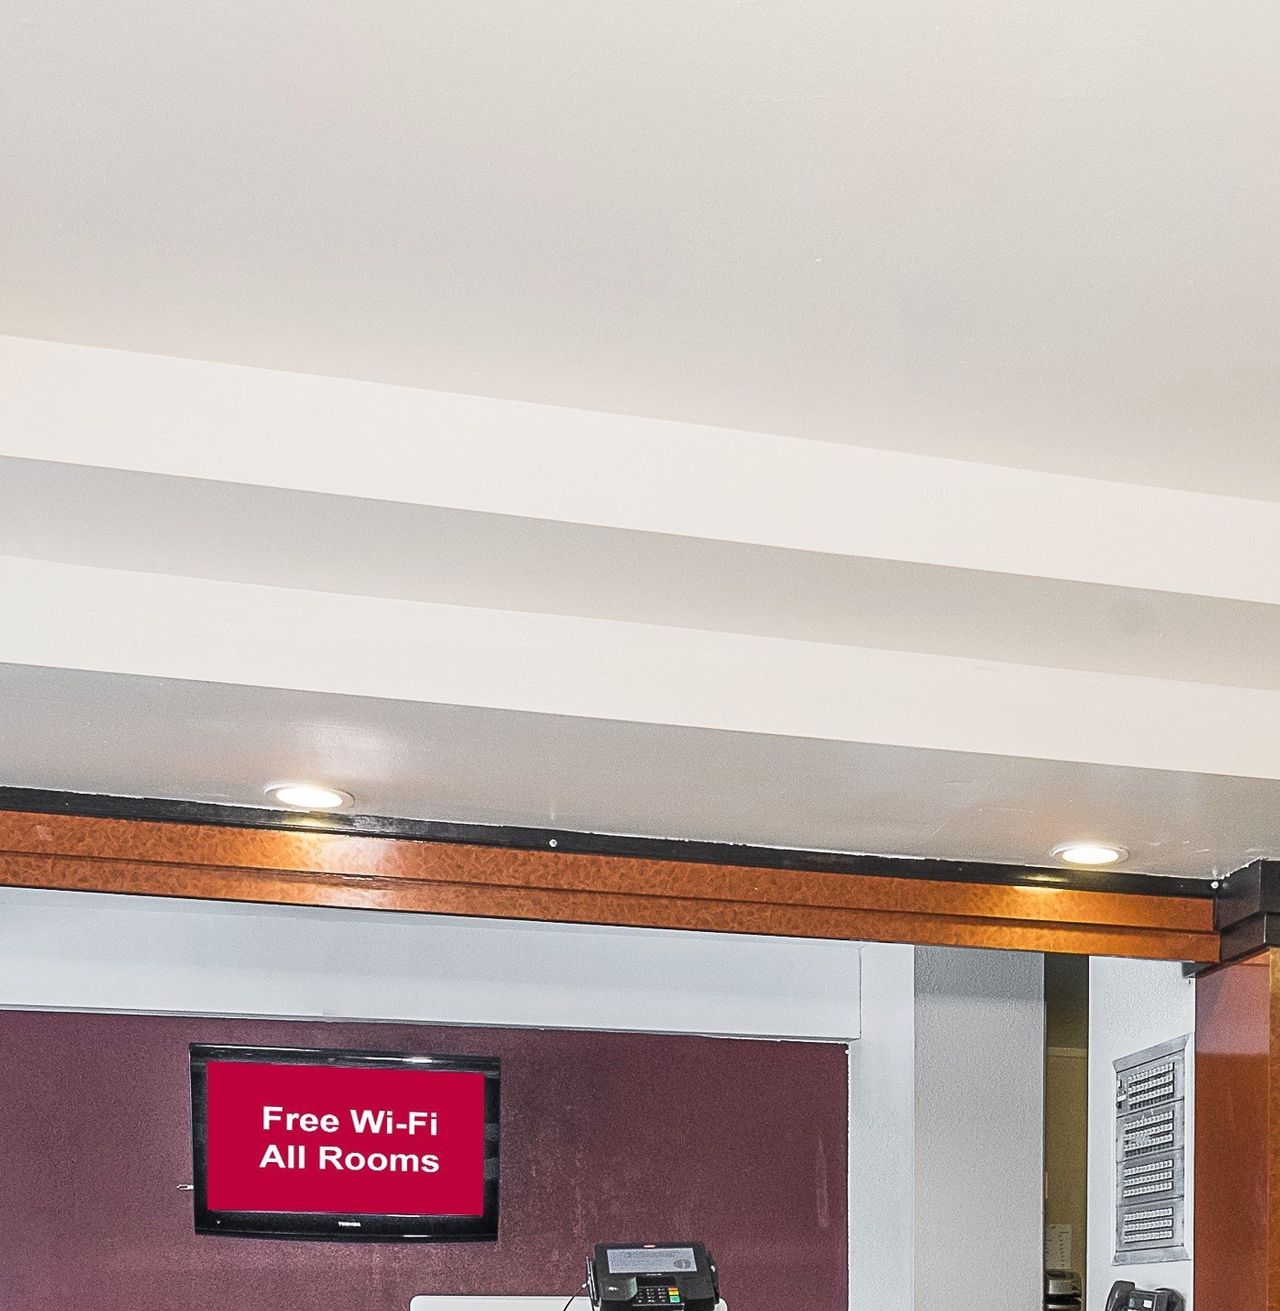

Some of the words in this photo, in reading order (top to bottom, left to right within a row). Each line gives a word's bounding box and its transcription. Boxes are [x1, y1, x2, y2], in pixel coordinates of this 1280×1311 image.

[262, 1105, 340, 1133] Free
[349, 1109, 438, 1136] Wi-Fi
[258, 1144, 306, 1169] All
[318, 1145, 440, 1173] Rooms
